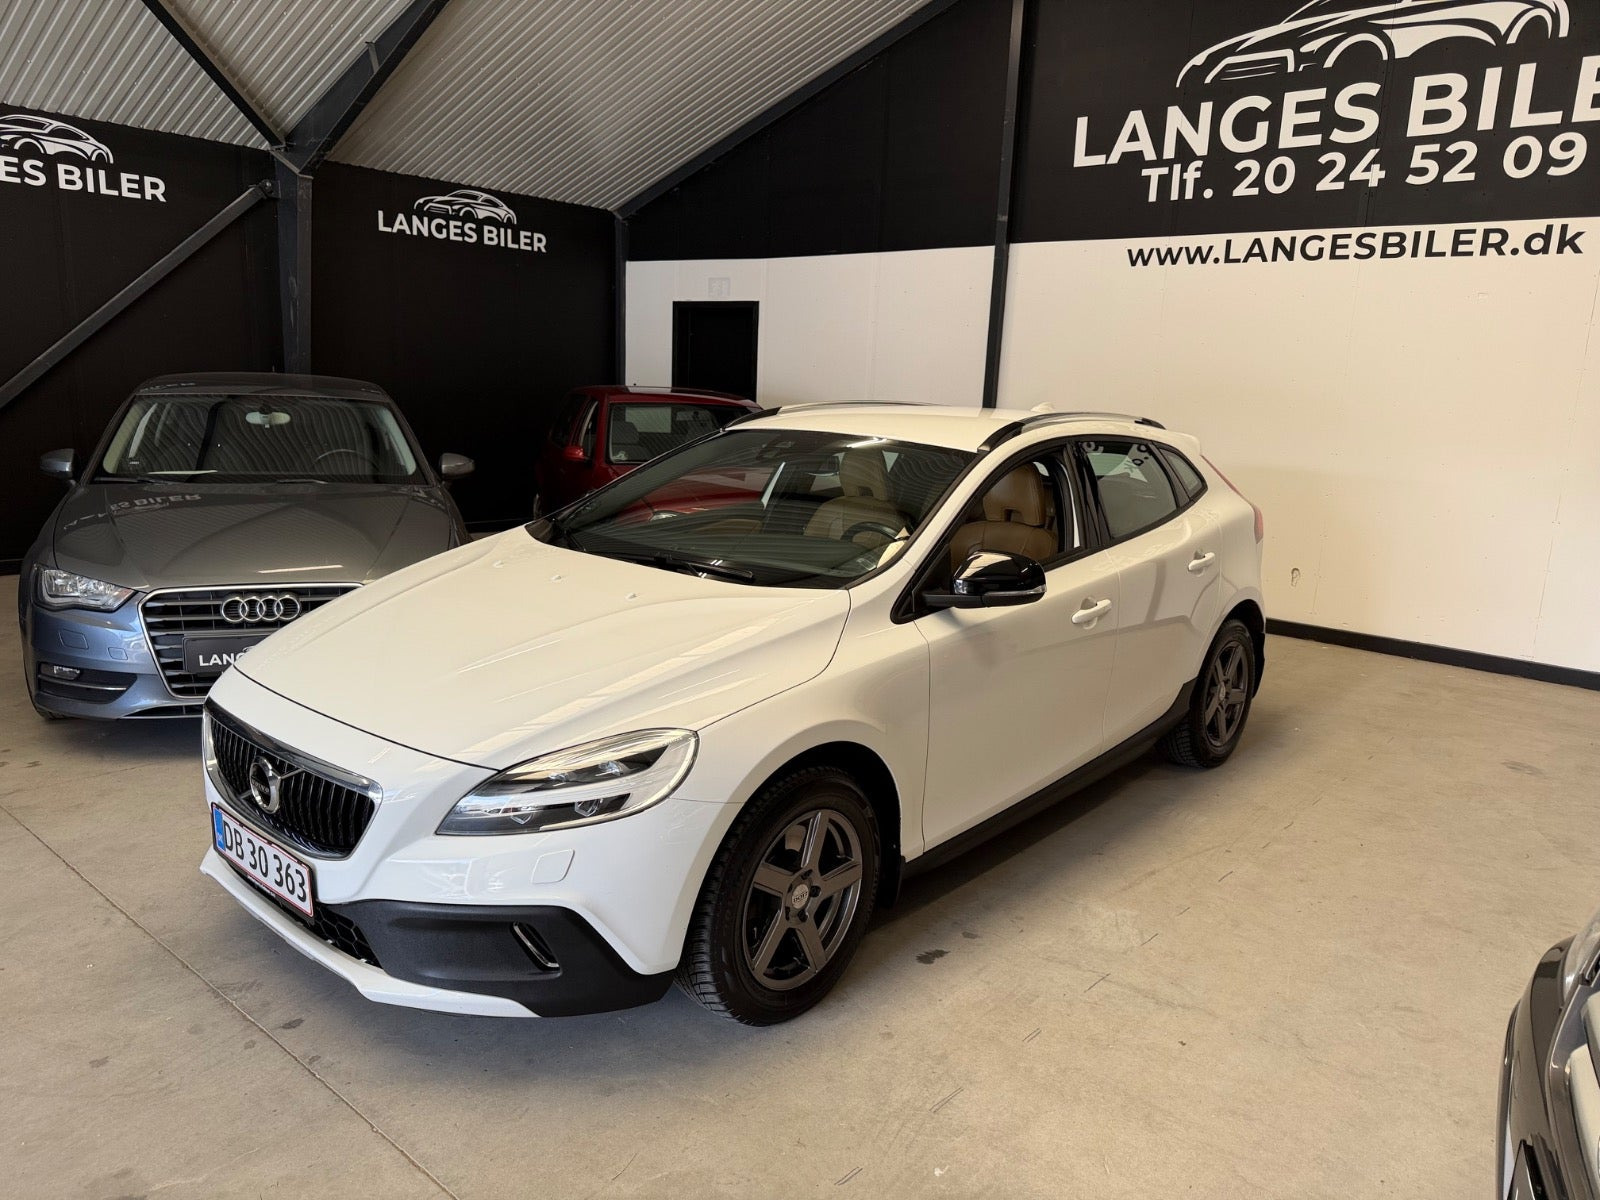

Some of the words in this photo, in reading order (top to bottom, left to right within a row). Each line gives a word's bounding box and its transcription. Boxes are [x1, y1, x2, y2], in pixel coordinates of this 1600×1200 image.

[1073, 81, 1382, 168] LANGES
[0, 155, 47, 187] ES
[57, 163, 167, 203] BILER
[1141, 160, 1214, 203] Tlf.
[1232, 156, 1296, 197] 20
[1316, 148, 1386, 192] 24
[1405, 141, 1478, 185] 52
[1502, 132, 1588, 179] 09
[377, 209, 478, 243] LANGES
[483, 225, 547, 253] BILER
[1127, 223, 1586, 267] www.LANGESBILER.dk
[223, 820, 245, 861] DB
[247, 838, 268, 878] 30
[273, 853, 307, 903] 363
